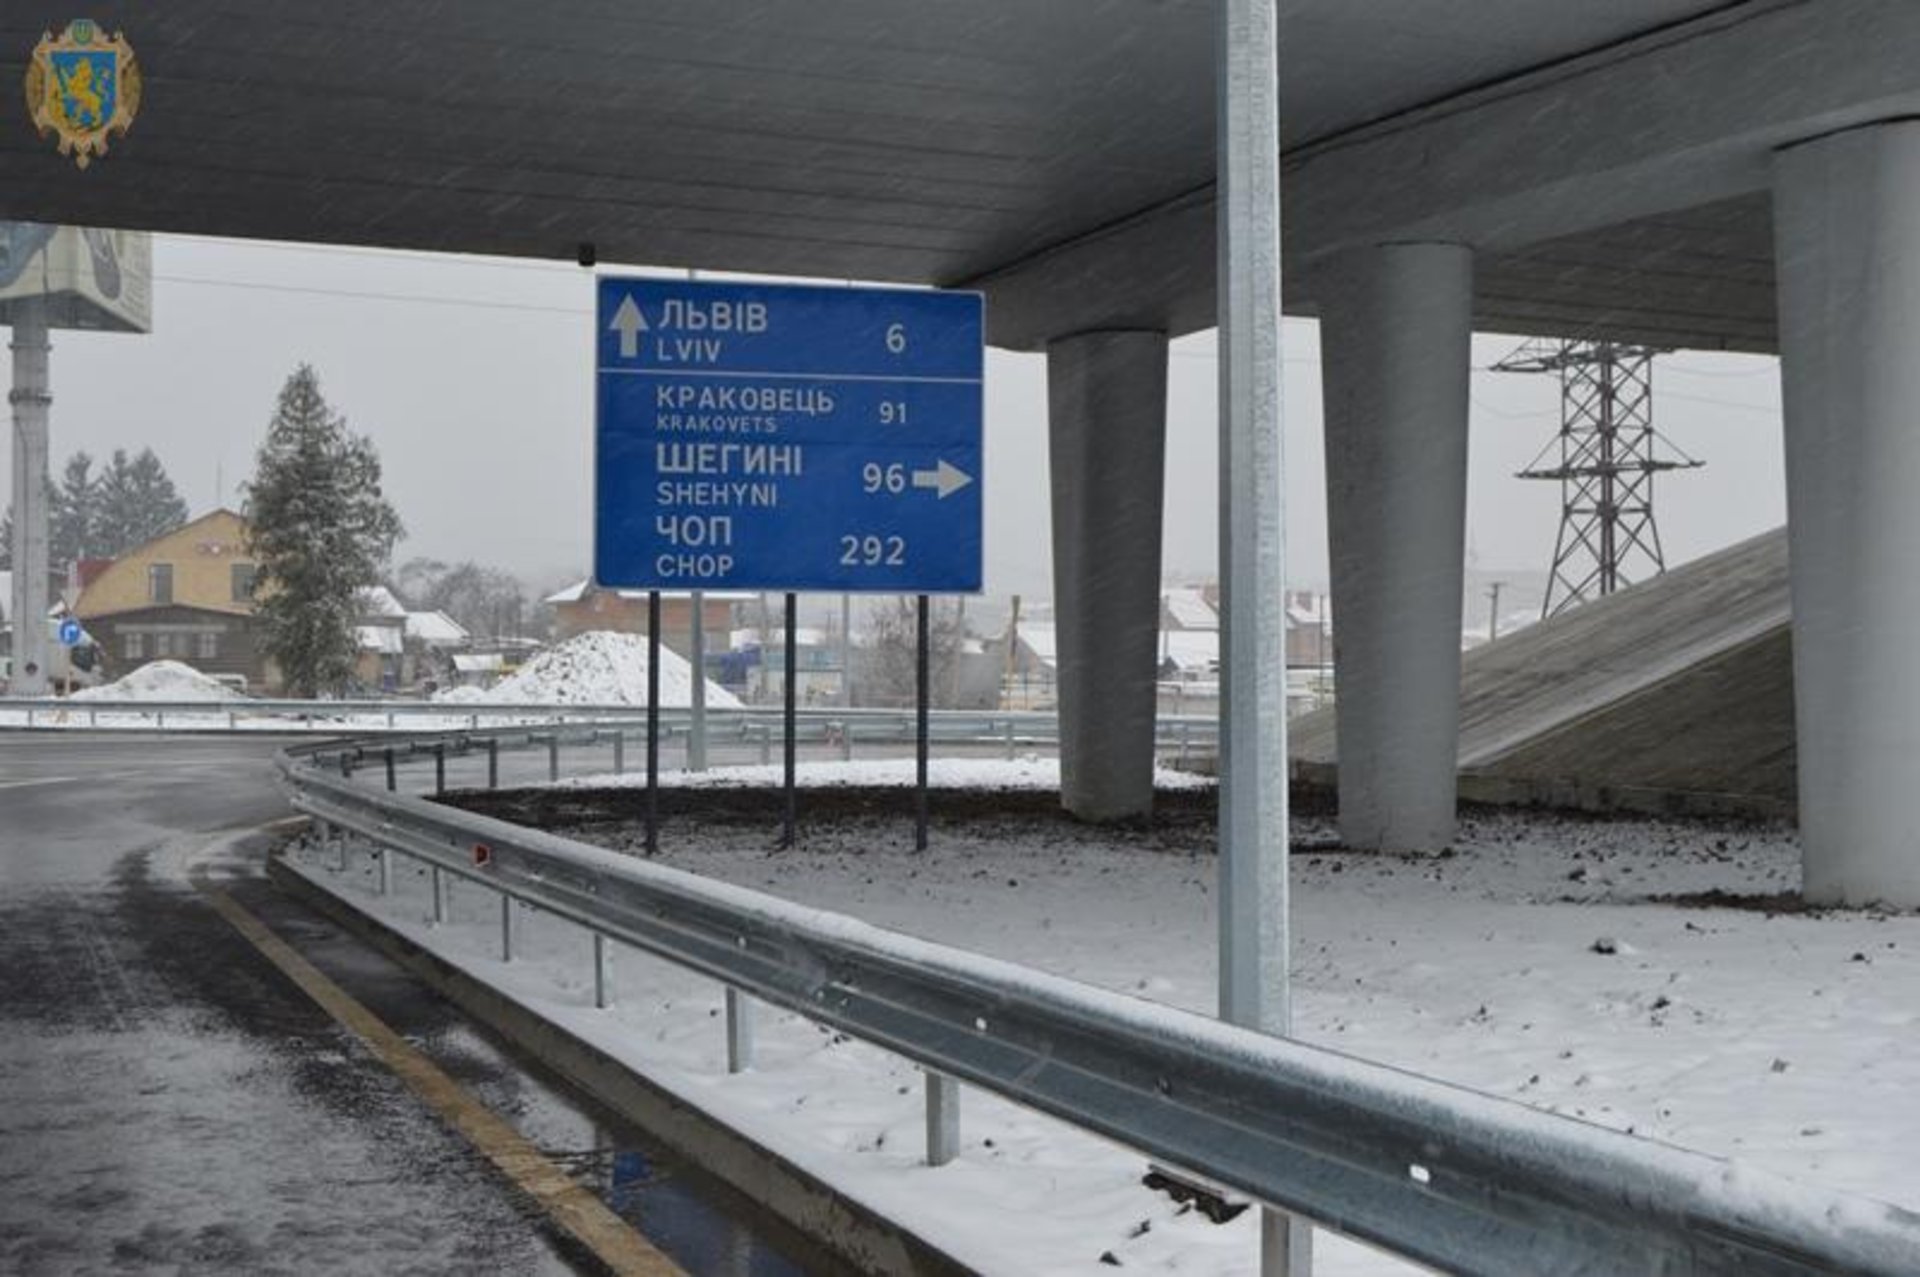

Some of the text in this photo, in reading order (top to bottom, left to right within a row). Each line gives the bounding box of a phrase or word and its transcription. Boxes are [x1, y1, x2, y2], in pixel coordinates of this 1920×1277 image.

[658, 300, 768, 332] ЛЬВІВ
[657, 338, 722, 361] LVIV
[886, 324, 905, 353] 6
[656, 386, 834, 415] КРАКОВЕЦЬ
[879, 401, 907, 424] 91
[656, 415, 778, 433] KRAKOVETS
[656, 444, 802, 476] ШЕГИНІ
[863, 463, 905, 494] 96
[656, 482, 778, 506] SHEHYNI
[656, 516, 732, 546] ЧОП
[840, 536, 905, 566] 292
[656, 555, 734, 577] CHOP
